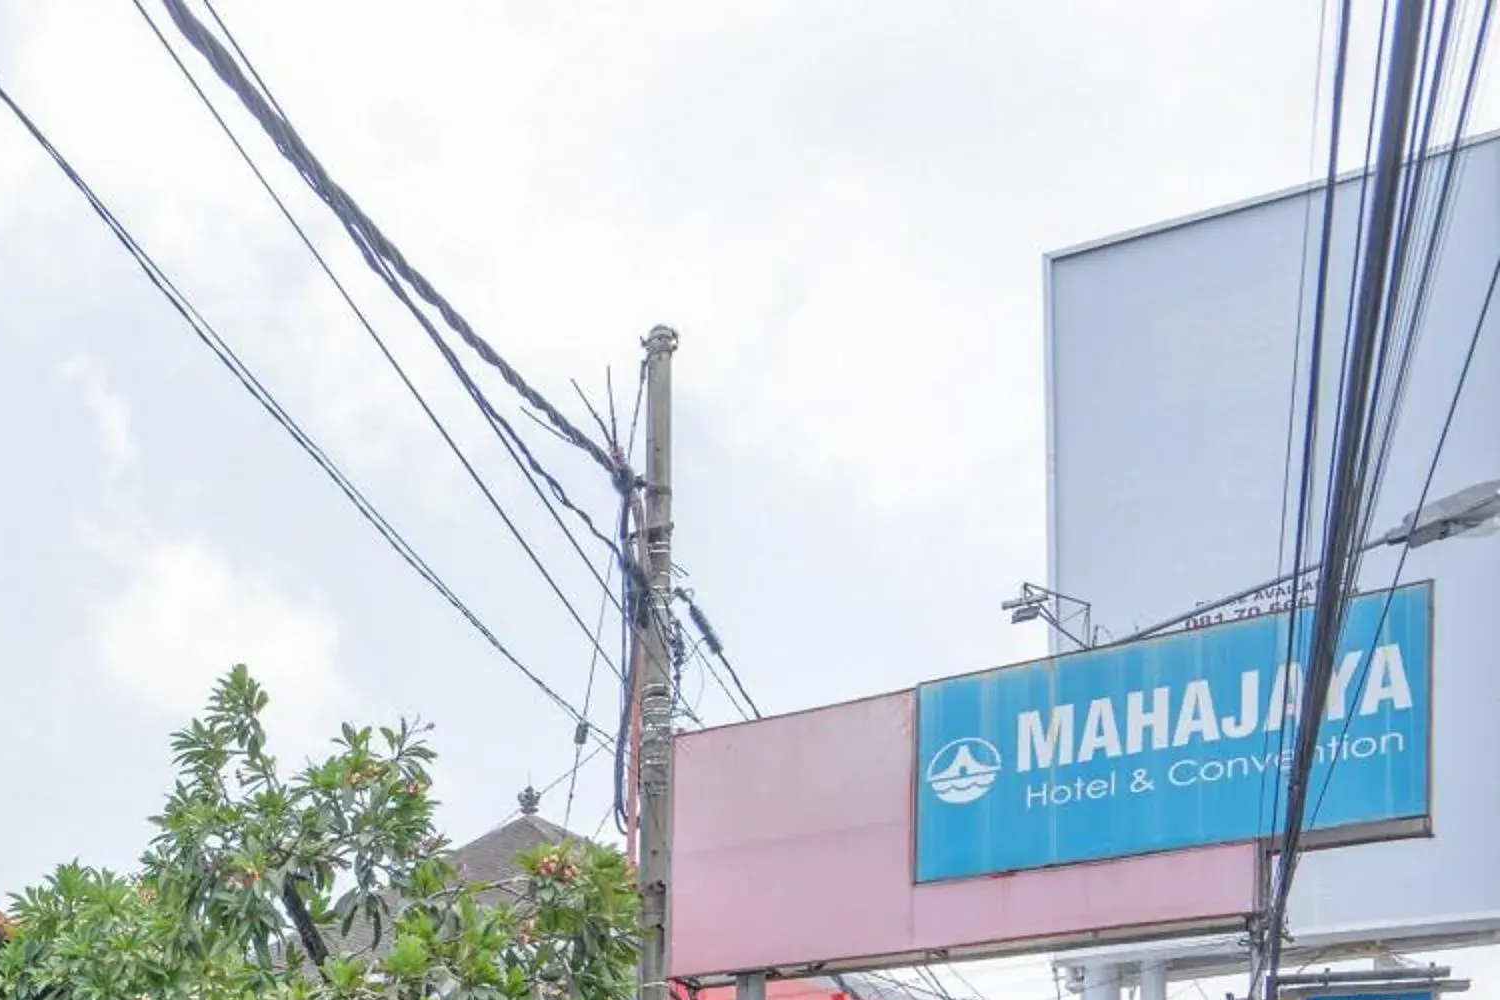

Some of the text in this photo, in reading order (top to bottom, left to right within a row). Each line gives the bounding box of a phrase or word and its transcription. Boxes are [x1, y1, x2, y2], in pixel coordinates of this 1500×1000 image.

[1017, 643, 1412, 772] MAHAJAYA
[1026, 773, 1117, 810] Hotel
[1130, 768, 1154, 794] &
